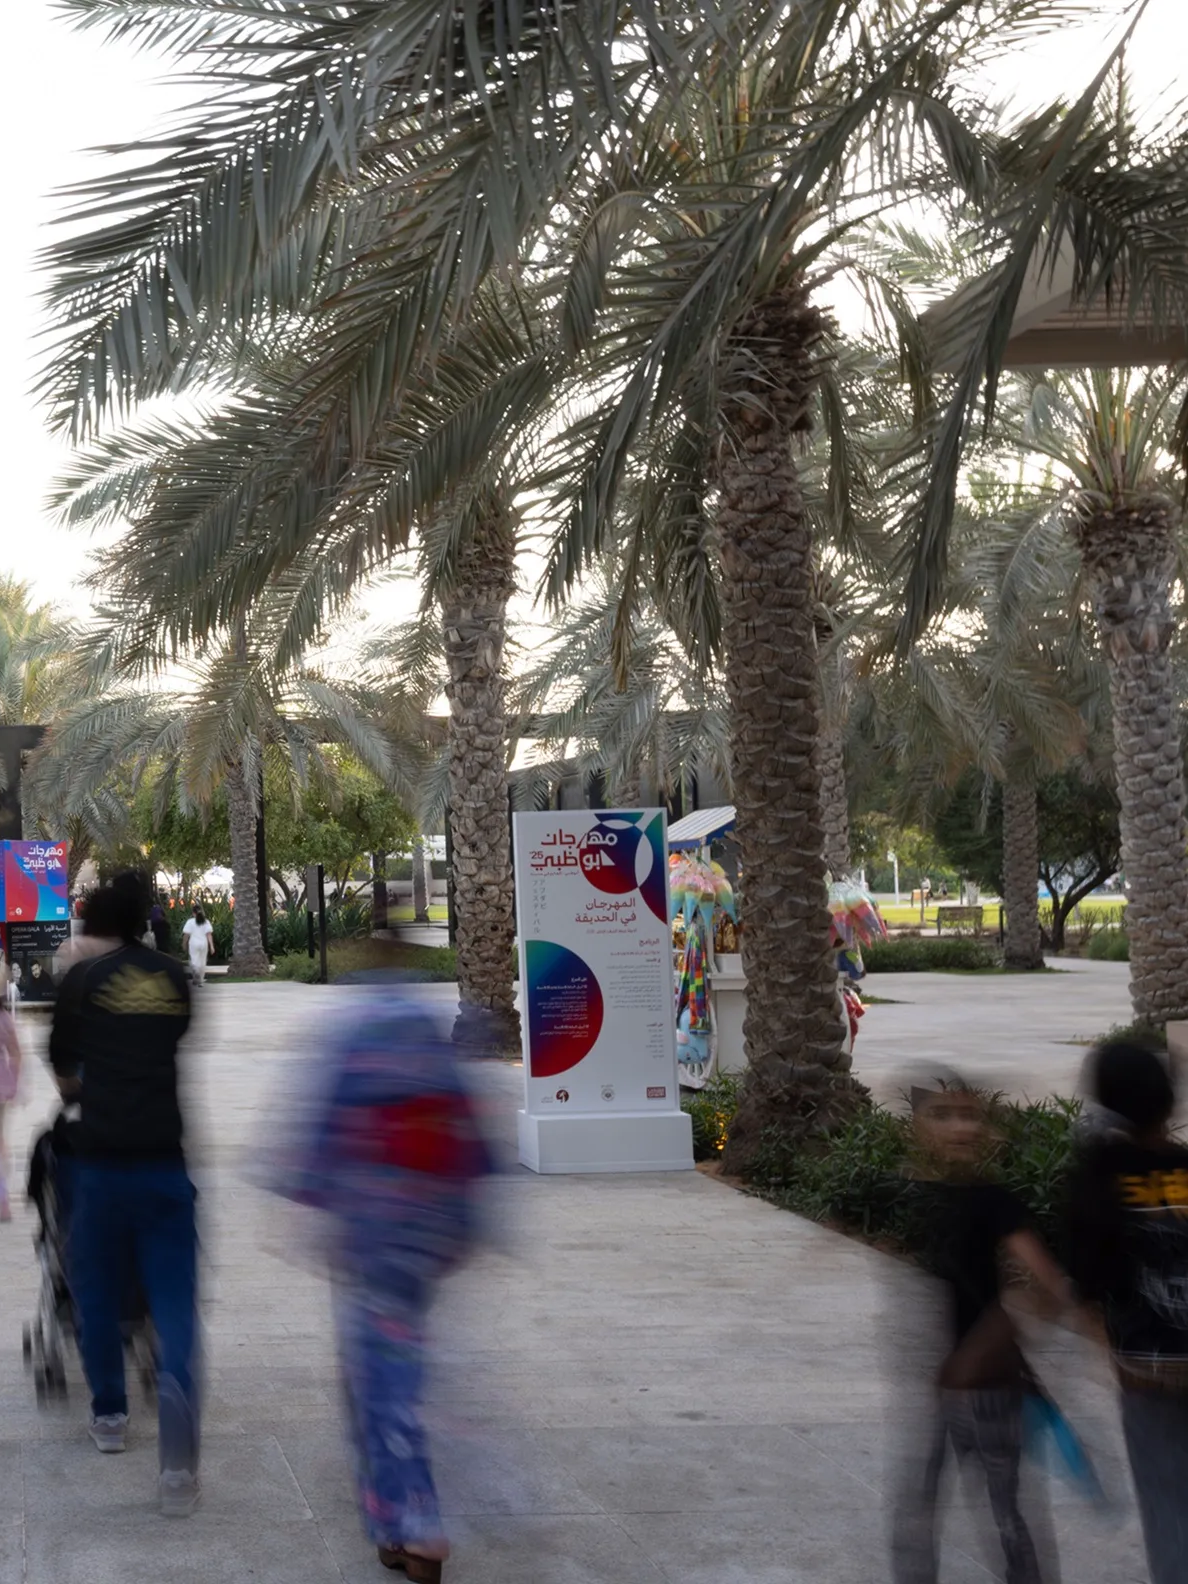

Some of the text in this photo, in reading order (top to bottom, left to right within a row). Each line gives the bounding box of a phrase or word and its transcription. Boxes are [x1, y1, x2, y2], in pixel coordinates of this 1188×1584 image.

[541, 828, 618, 849] مهرجان
[585, 897, 636, 911] المهرجان
[575, 911, 637, 926] في الحديقة
